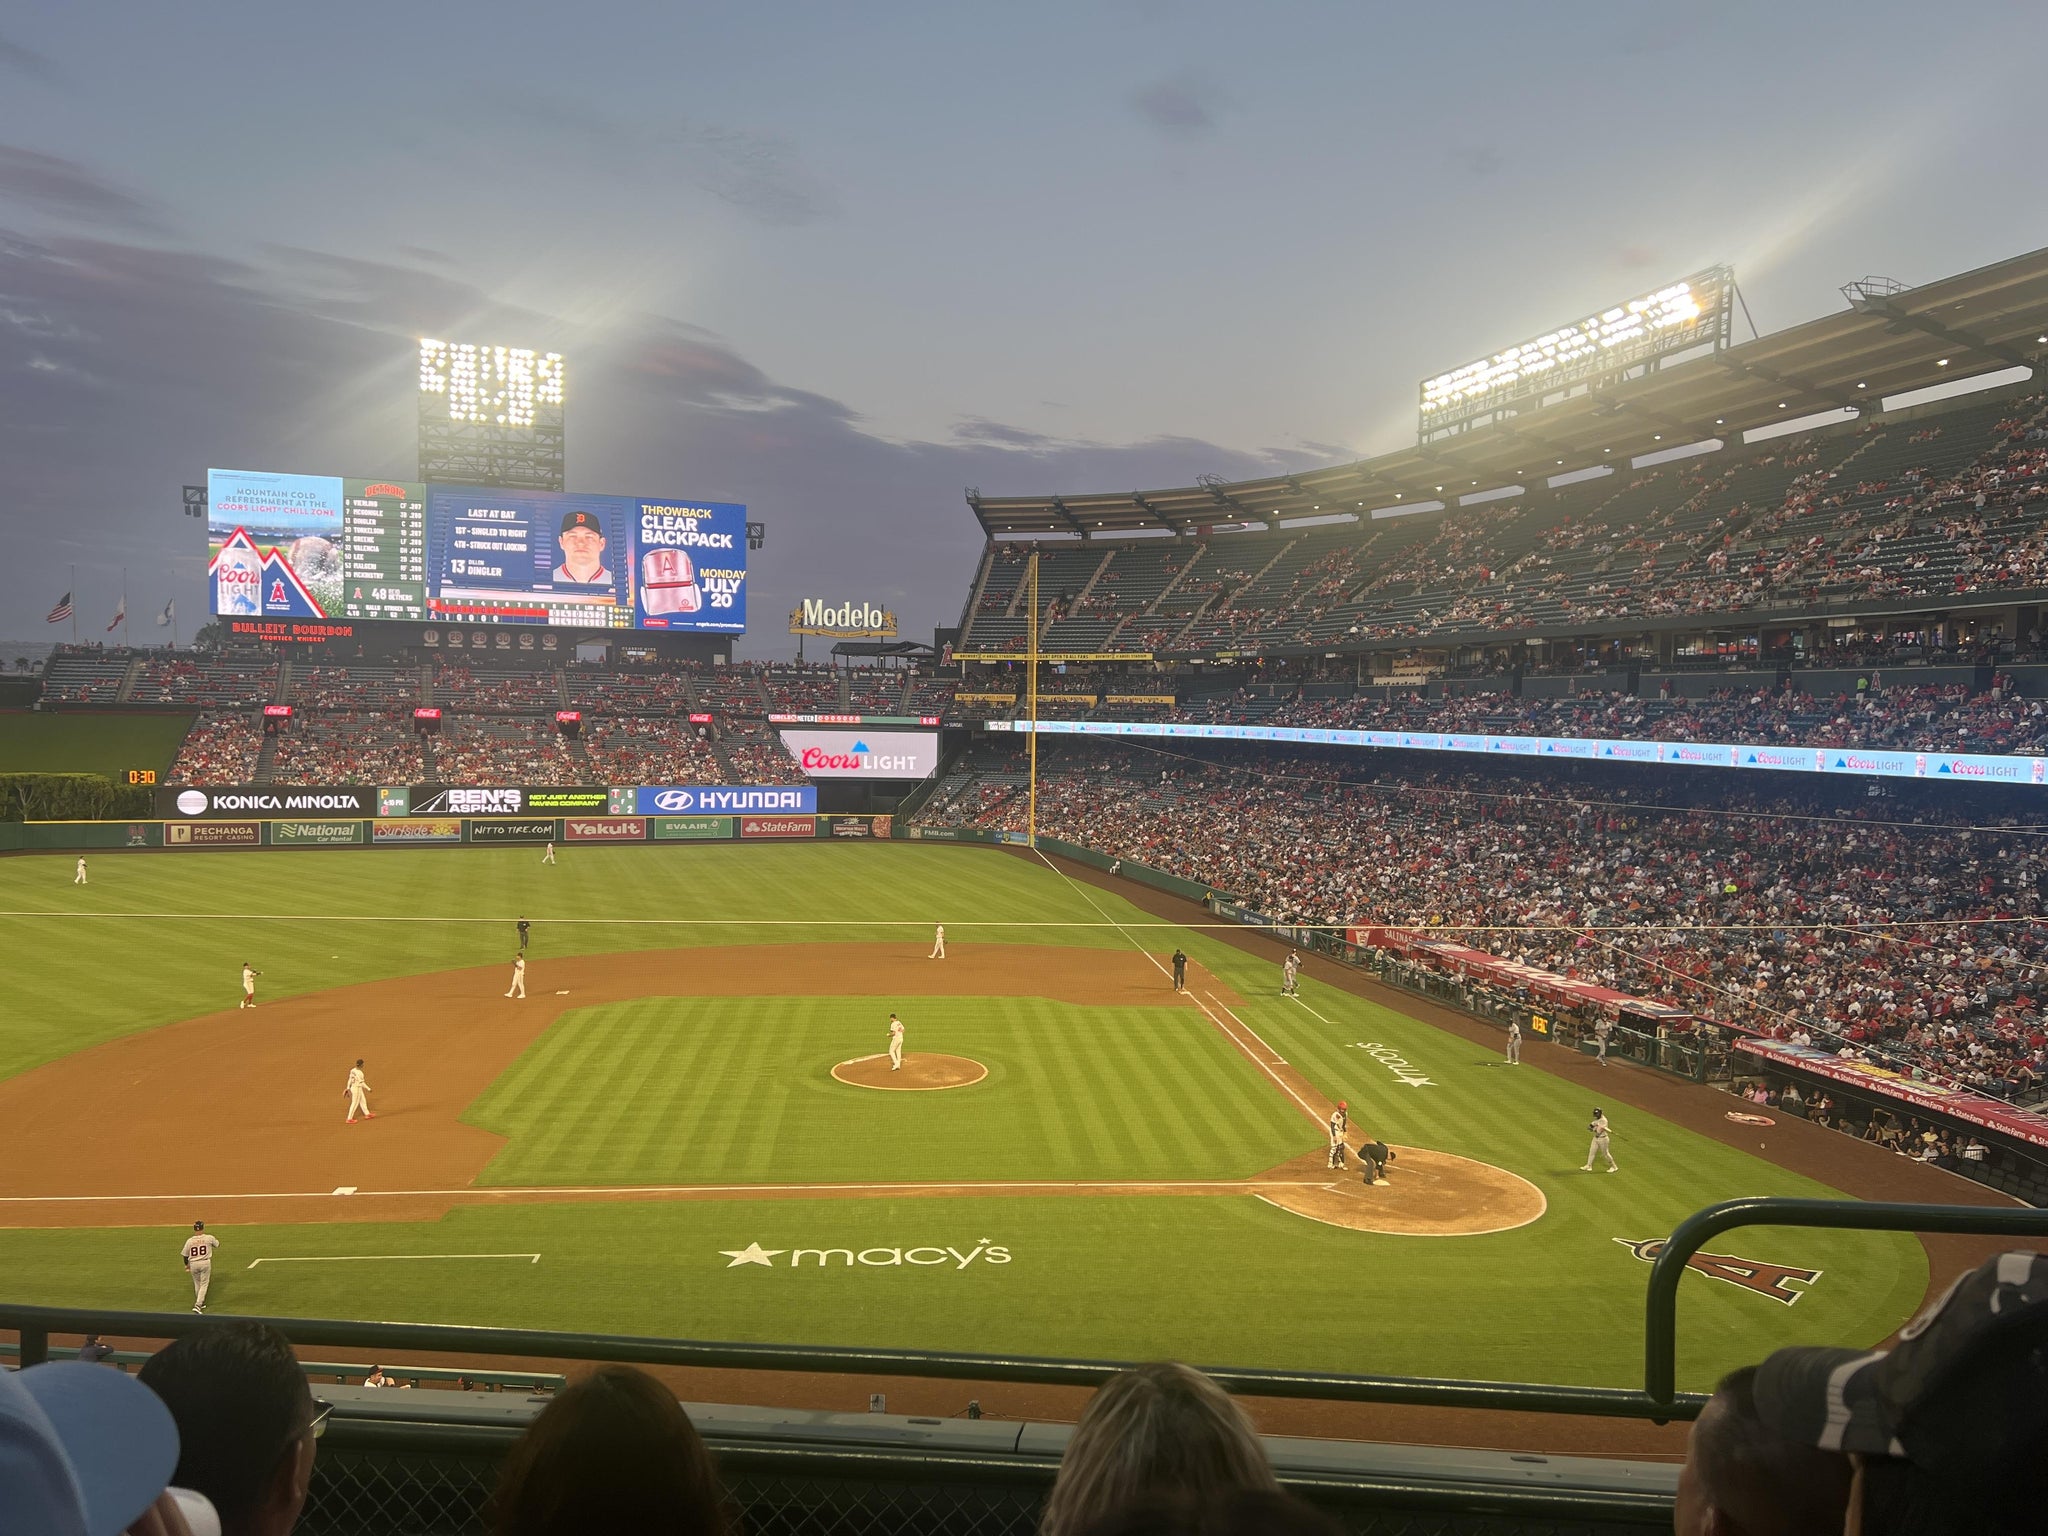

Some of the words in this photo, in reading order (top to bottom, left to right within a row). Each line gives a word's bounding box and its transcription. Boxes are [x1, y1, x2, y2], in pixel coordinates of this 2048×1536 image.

[236, 488, 288, 497] MOUNTAIN
[365, 483, 406, 500] DETROIT
[217, 503, 248, 511] COORS
[225, 496, 293, 506] REFRESHMENT
[468, 508, 488, 518] LAST
[500, 511, 516, 519] BAT
[641, 505, 712, 519] THROWBACK
[641, 515, 698, 532] CLEAR
[455, 526, 466, 534] 1ST
[471, 528, 498, 536] SINGLED
[499, 529, 508, 537] TO
[508, 530, 528, 538] RIGHT
[641, 529, 732, 548] BACKPACK
[470, 541, 492, 550] STRUCK
[492, 542, 503, 550] OUT
[504, 543, 528, 552] LOOKING
[451, 559, 465, 574] 13
[662, 552, 676, 575] A
[468, 566, 502, 576] DINGLER
[700, 568, 746, 580] MONDAY
[269, 578, 289, 602] A
[702, 578, 741, 594] JULY
[372, 588, 387, 600] 48
[710, 593, 733, 608] 20
[804, 598, 883, 628] Modelo
[232, 622, 287, 634] BULLEIT
[292, 624, 352, 636] BOURBON
[940, 641, 956, 666] A
[802, 746, 860, 769] Coors
[864, 756, 916, 770] LIGHT
[1758, 752, 1781, 764] Coors
[1783, 756, 1806, 766] LIGHT
[1848, 756, 1875, 769] Coors
[1877, 762, 1904, 771] LIGHT
[1952, 760, 1985, 774] Coors
[1986, 766, 2018, 777] LIGHT
[129, 770, 156, 784] 0:30
[380, 789, 389, 799] P
[449, 790, 521, 804] BEN'S
[627, 790, 633, 798] 5
[701, 792, 801, 808] HYUNDAI
[213, 796, 282, 809] KONICA
[285, 796, 360, 808] MINOLTA
[449, 804, 521, 812] ASPHALT
[627, 805, 632, 814] 2
[298, 824, 355, 836] National
[378, 824, 428, 838] Surfside
[474, 825, 504, 834] NITTO
[508, 825, 552, 834] TIRE.COM
[570, 823, 640, 835] Yakult
[761, 822, 811, 833] StateFarm
[1773, 1053, 1796, 1066] StateFarm
[1805, 1064, 1830, 1076] StateFarm
[1840, 1073, 1866, 1087] StateFarm
[1876, 1084, 1904, 1099] StateFarm
[1915, 1096, 1944, 1111] StateFarm
[1955, 1110, 1984, 1125] StateFarm
[1995, 1122, 2026, 1138] StateFarm
[191, 1246, 207, 1256] 88
[791, 1237, 1012, 1270] macy's
